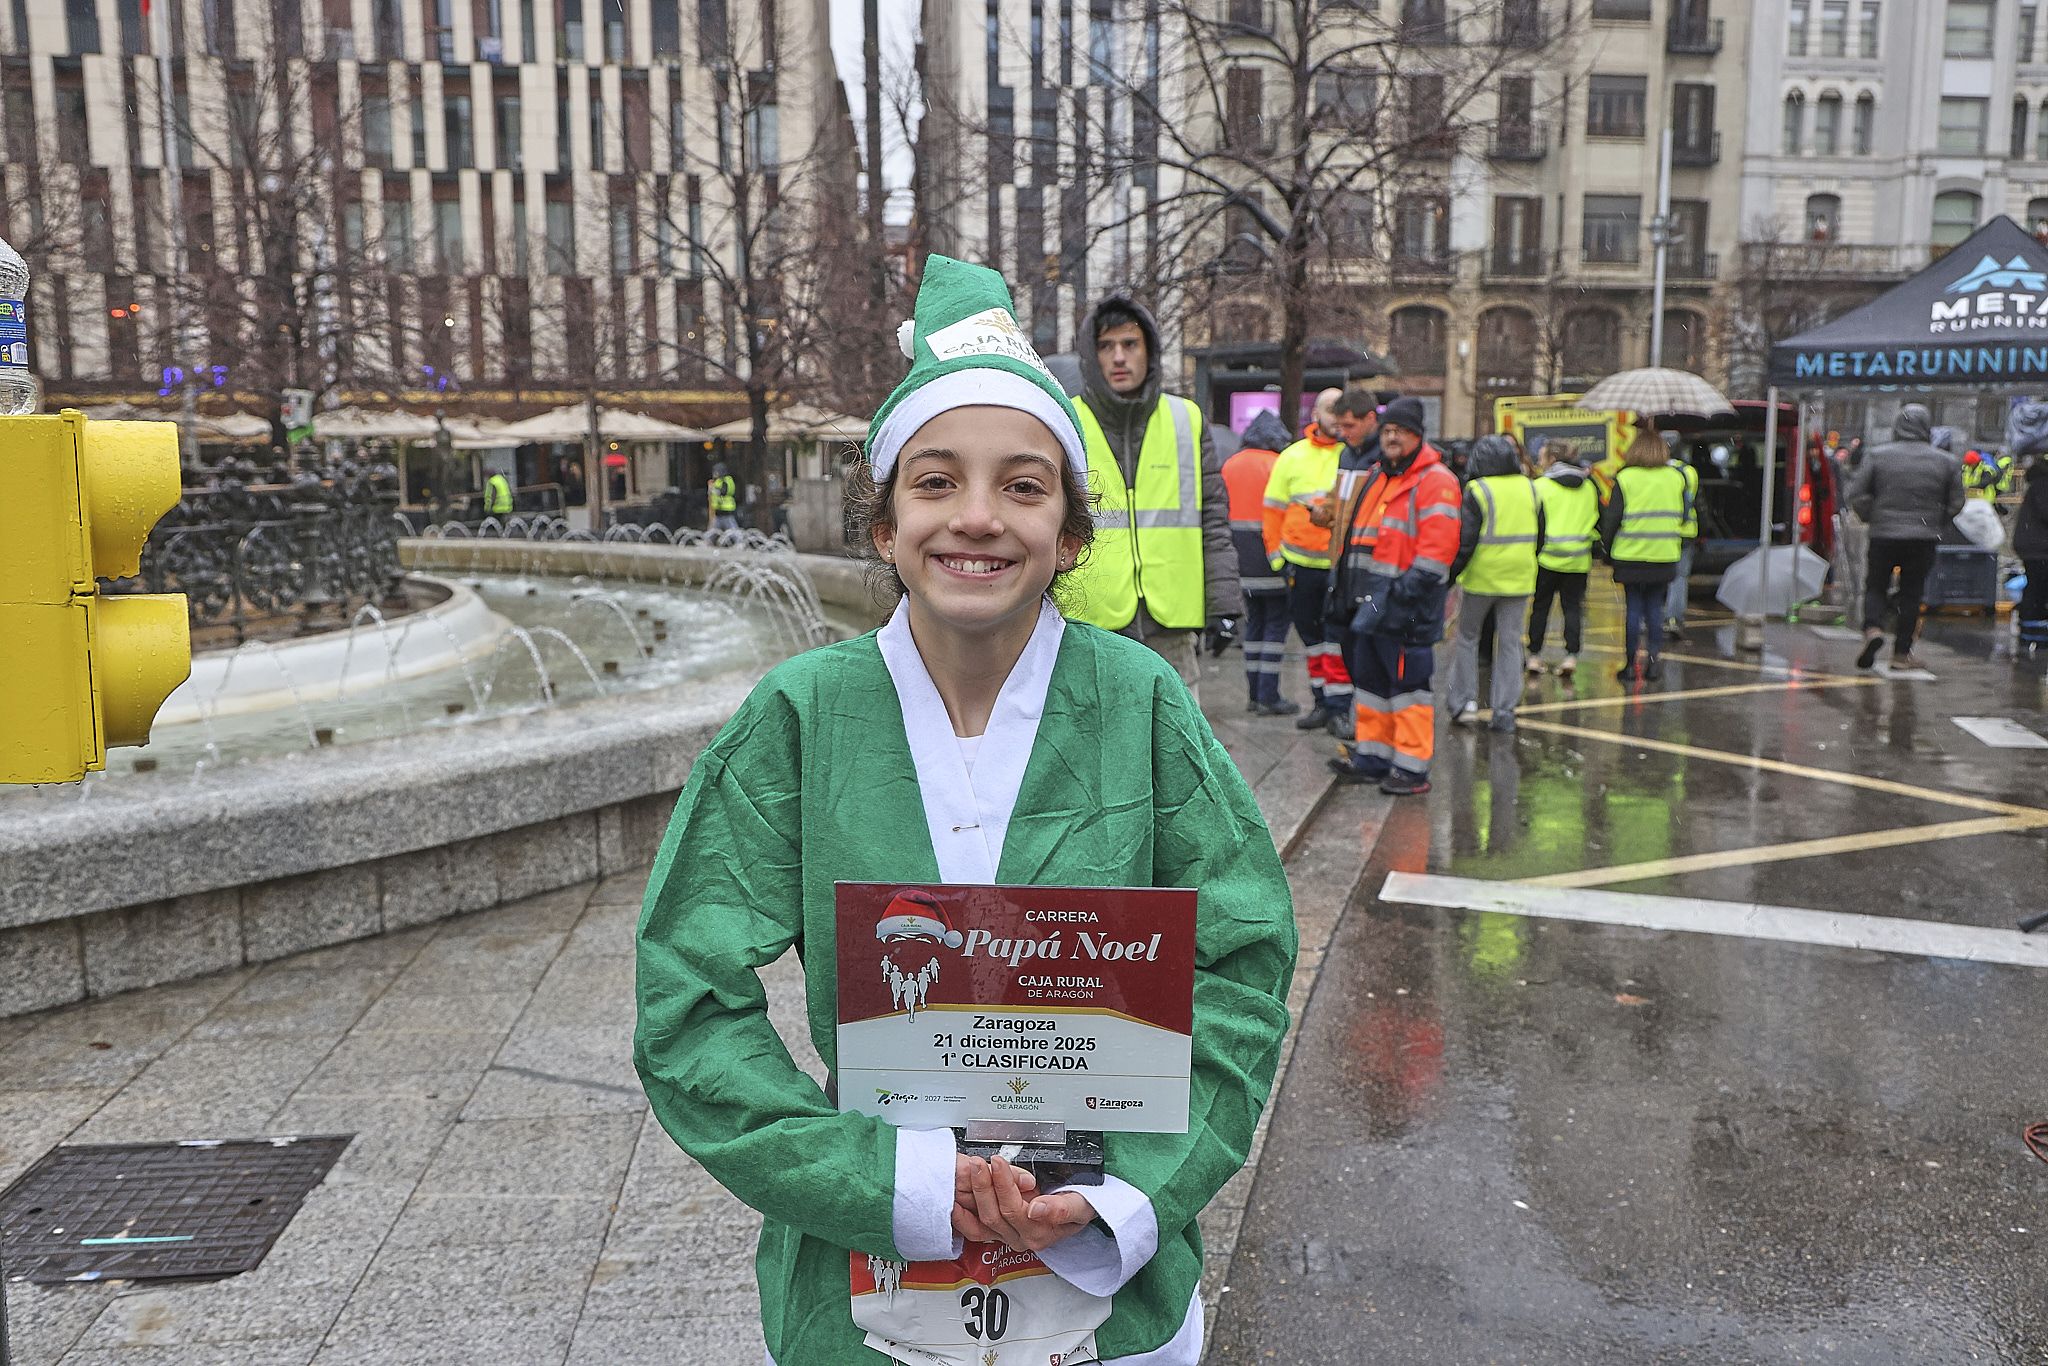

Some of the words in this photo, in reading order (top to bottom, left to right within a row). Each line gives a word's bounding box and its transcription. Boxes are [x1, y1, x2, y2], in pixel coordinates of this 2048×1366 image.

[943, 334, 1001, 354] CAJA
[963, 345, 988, 355] DE
[1025, 910, 1099, 923] CARRERA
[960, 930, 1062, 967] Papá
[1070, 931, 1162, 962] Noel
[1018, 975, 1053, 988] CAJA
[1056, 976, 1104, 989] RURAL
[1027, 989, 1043, 998] DE
[1045, 988, 1094, 999] ARAGÓN
[973, 1015, 1056, 1034] Zaragoza
[933, 1033, 953, 1048] 21
[960, 1034, 1049, 1050] diciembre
[1054, 1036, 1096, 1051] 2025
[941, 1052, 957, 1067] 1ª
[961, 1053, 1089, 1070] CLASIFICADA
[990, 1095, 1013, 1103] CAJA
[1015, 1096, 1045, 1104] RURAL
[1099, 1098, 1144, 1110] Zaragoza
[1008, 1103, 1039, 1111] ARAGÓN
[960, 1286, 1010, 1341] 30
